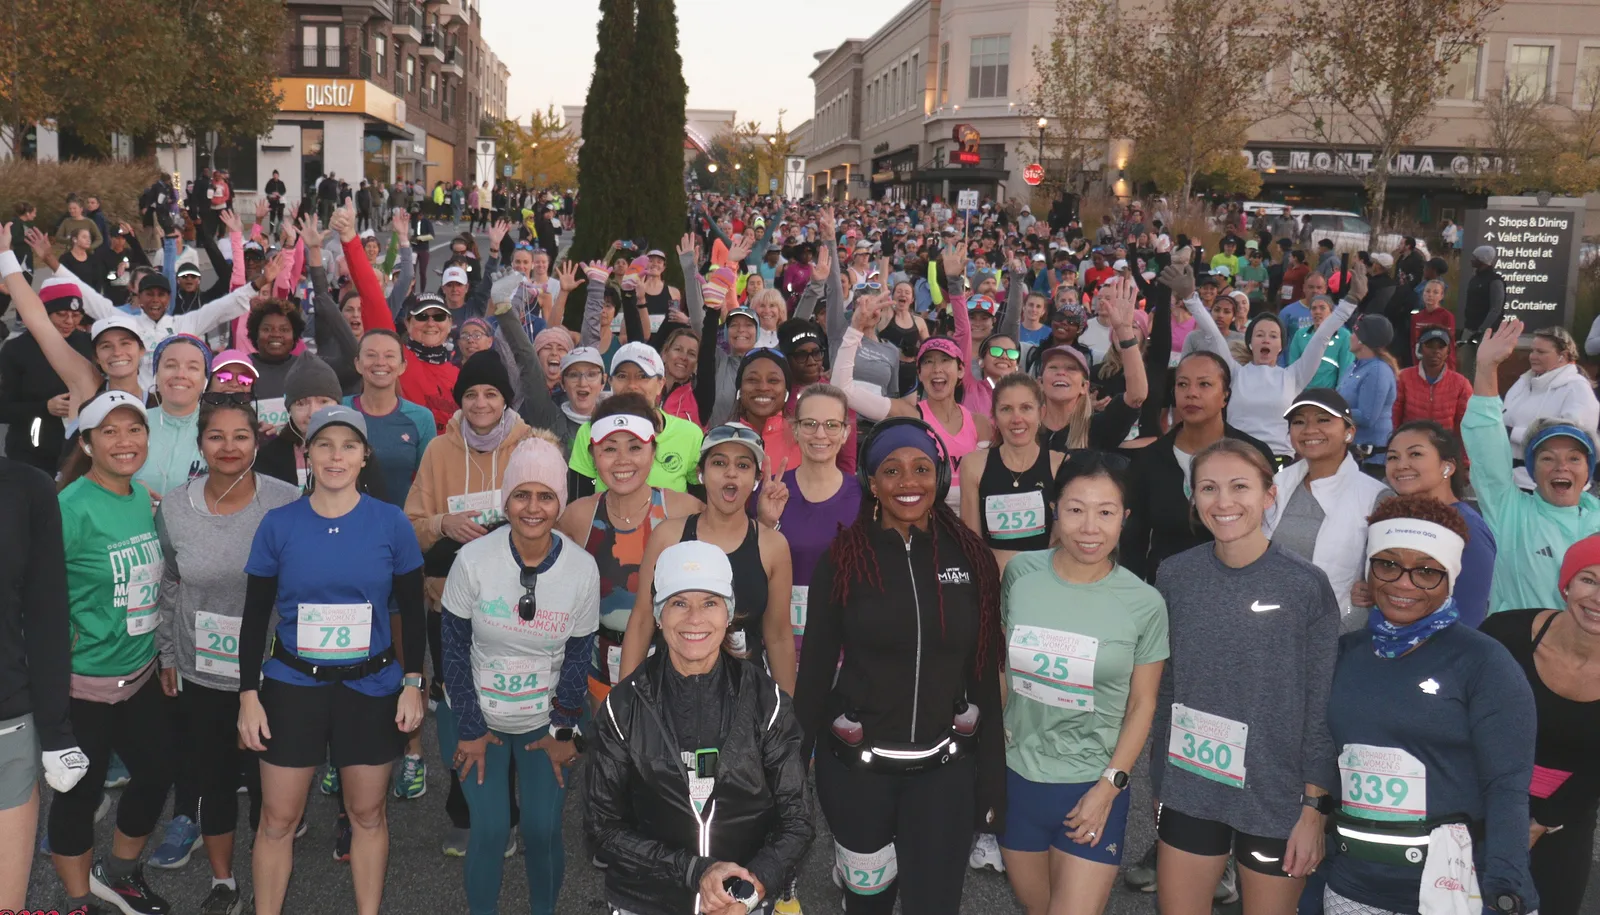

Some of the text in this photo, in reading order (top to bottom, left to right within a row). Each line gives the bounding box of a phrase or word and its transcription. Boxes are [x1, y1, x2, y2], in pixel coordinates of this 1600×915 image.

[305, 79, 354, 109] gusto!
[1498, 216, 1568, 230] Shops & Dining
[1497, 232, 1559, 245] Valet Parking
[1496, 247, 1553, 258] The Hotel at
[1494, 259, 1536, 270] Avalon &
[1511, 300, 1557, 311] Container
[996, 511, 1037, 530] 252
[937, 571, 970, 581] MIAMI
[207, 632, 238, 654] 20
[319, 626, 351, 648] 78
[1033, 653, 1069, 680] 25
[493, 673, 538, 692] 384
[1182, 733, 1232, 770] 360
[1348, 773, 1409, 807] 339
[842, 863, 887, 887] 127
